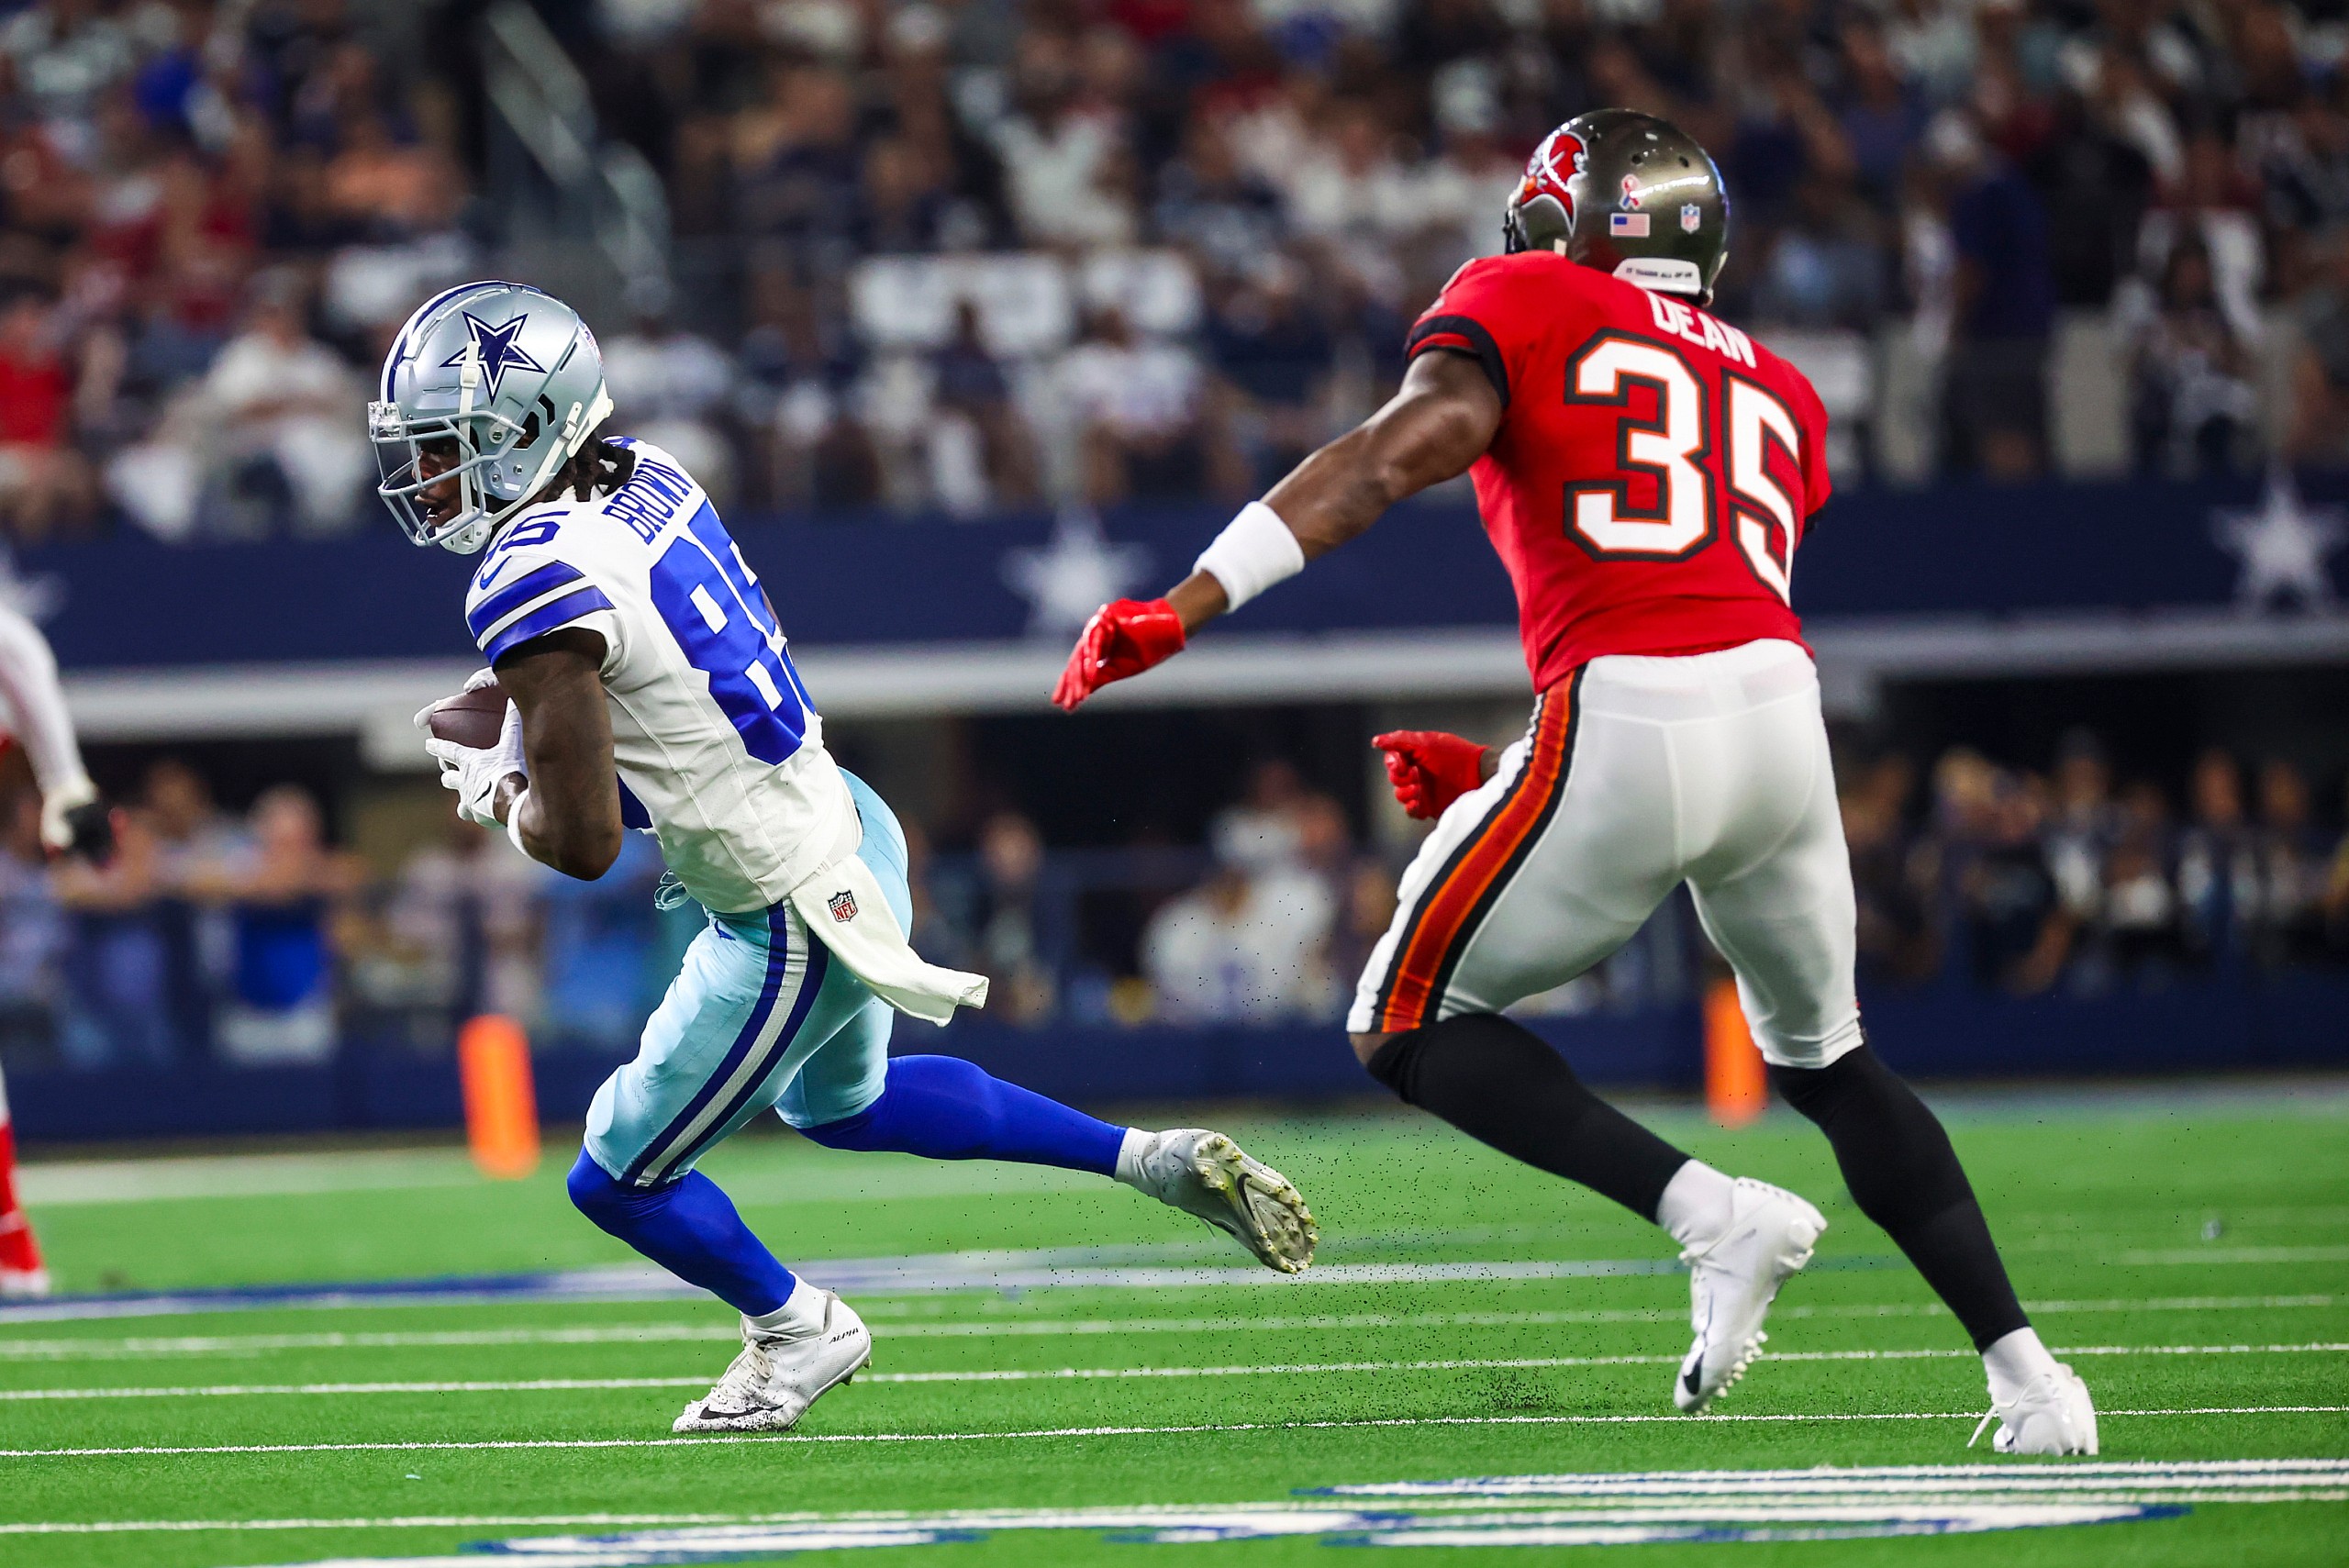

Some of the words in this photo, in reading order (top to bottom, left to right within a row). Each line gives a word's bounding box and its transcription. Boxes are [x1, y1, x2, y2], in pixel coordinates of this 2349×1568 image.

[1646, 288, 1757, 369] DEAN
[601, 458, 693, 545] BROWN
[1564, 327, 1803, 608] 35
[833, 902, 856, 920] NFL
[828, 1327, 858, 1344] ALPHA
